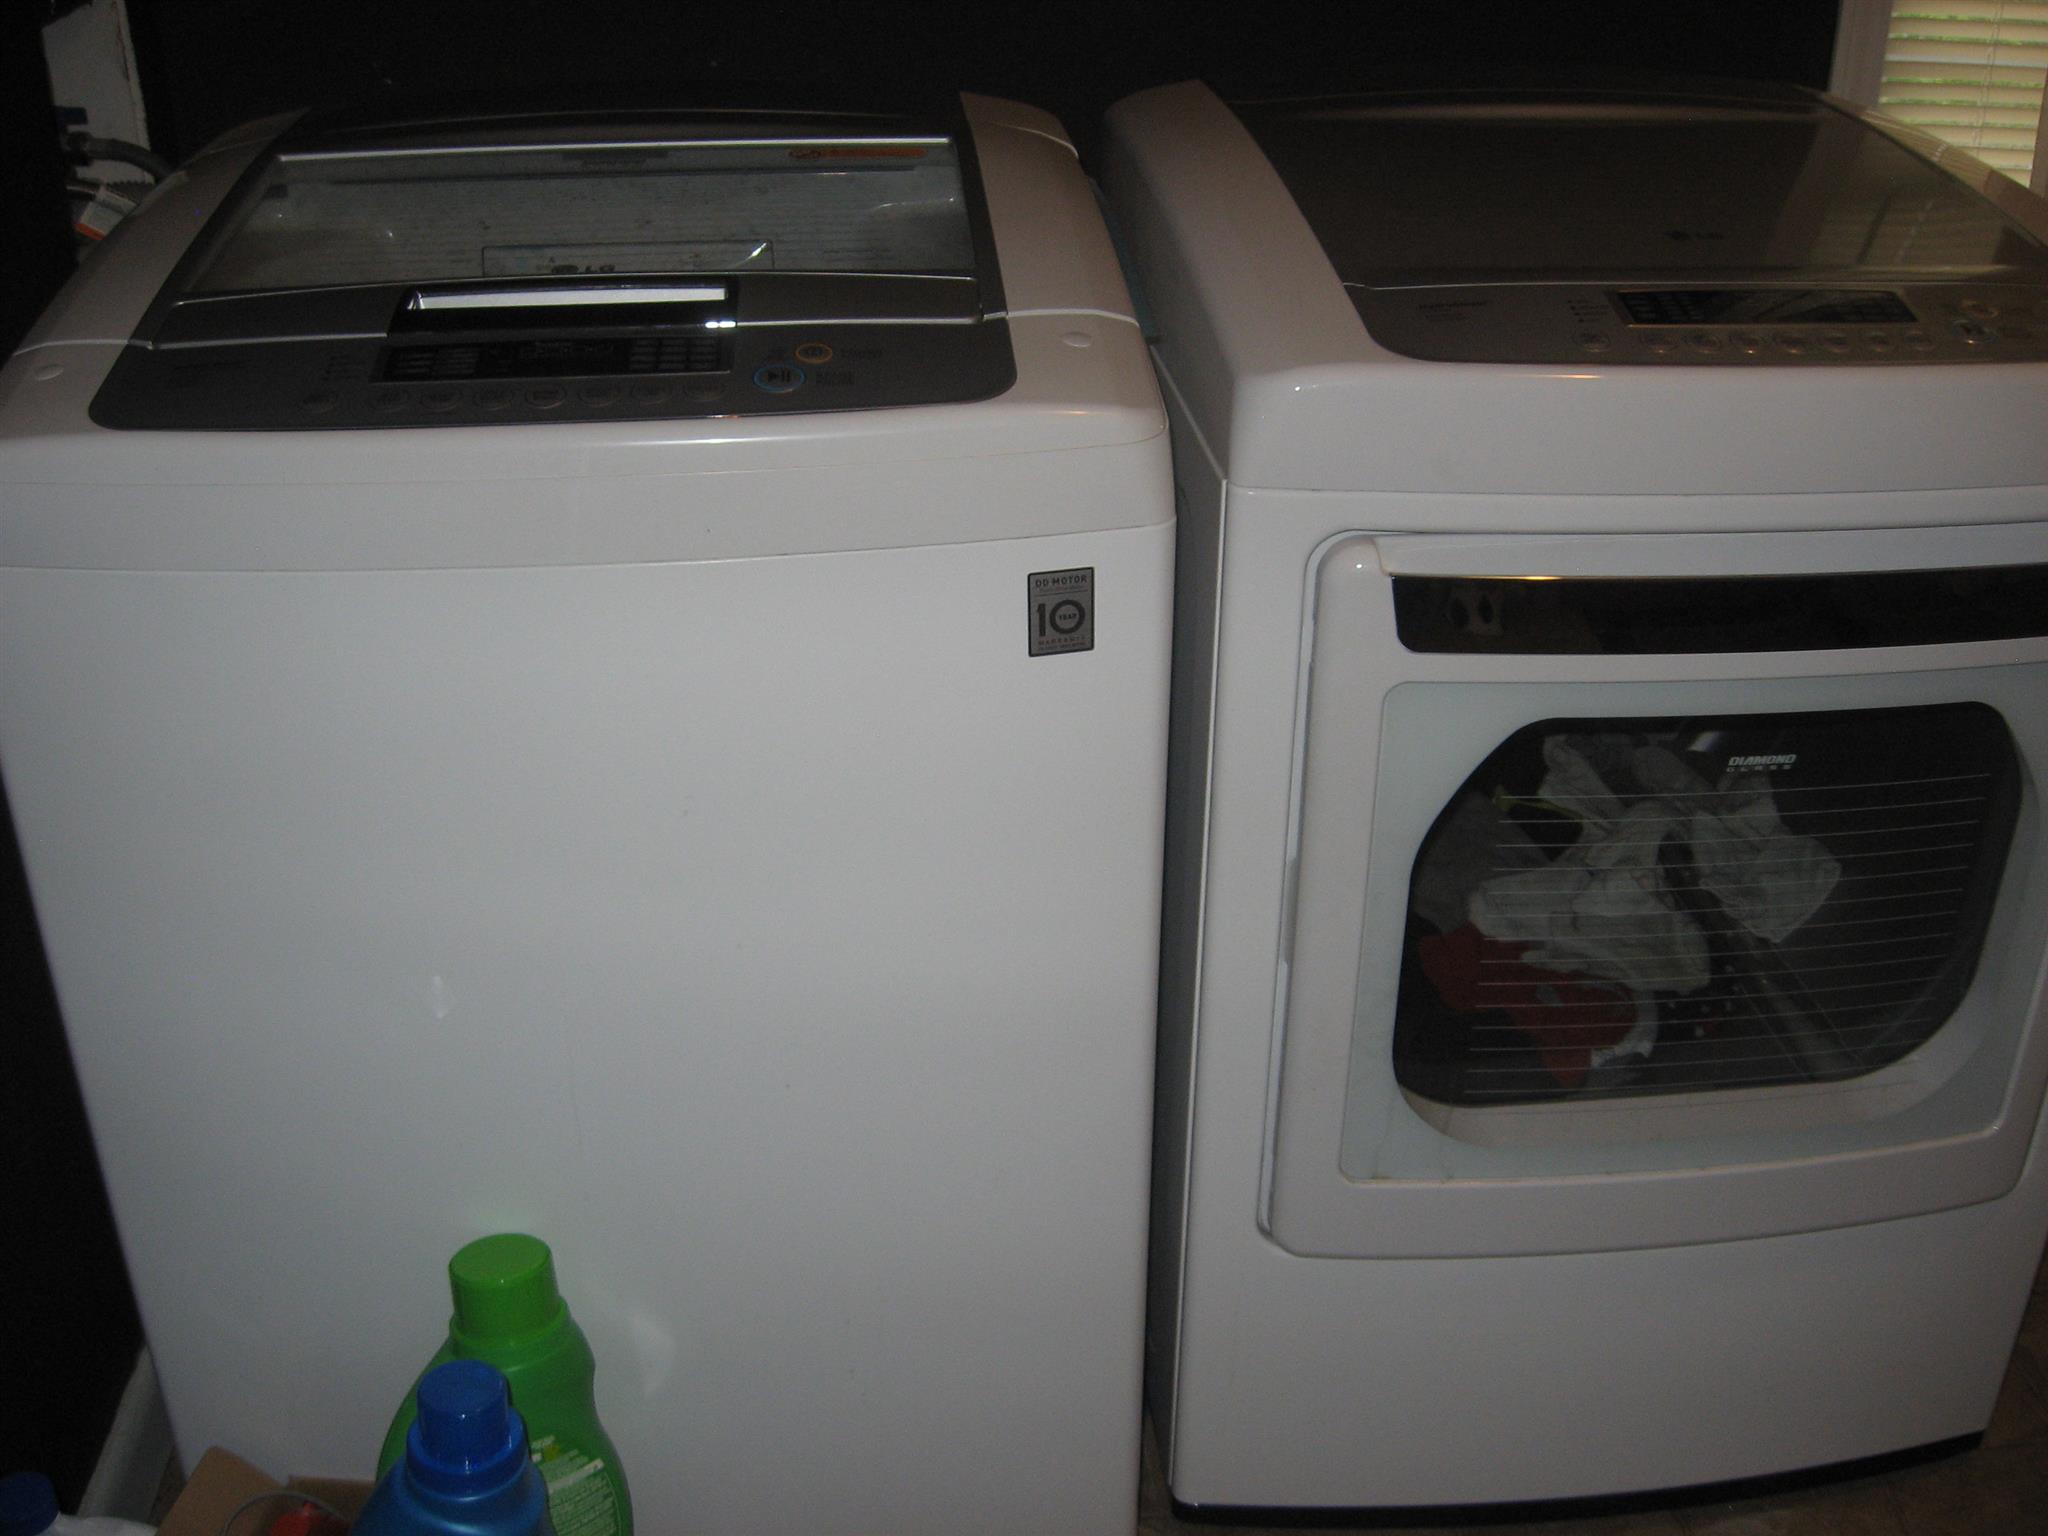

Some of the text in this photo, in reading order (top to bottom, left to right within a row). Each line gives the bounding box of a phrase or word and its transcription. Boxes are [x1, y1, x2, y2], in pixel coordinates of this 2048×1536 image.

[1053, 575, 1088, 585] MOTOR
[1036, 599, 1085, 637] 10
[1728, 754, 1797, 765] DIAMOND
